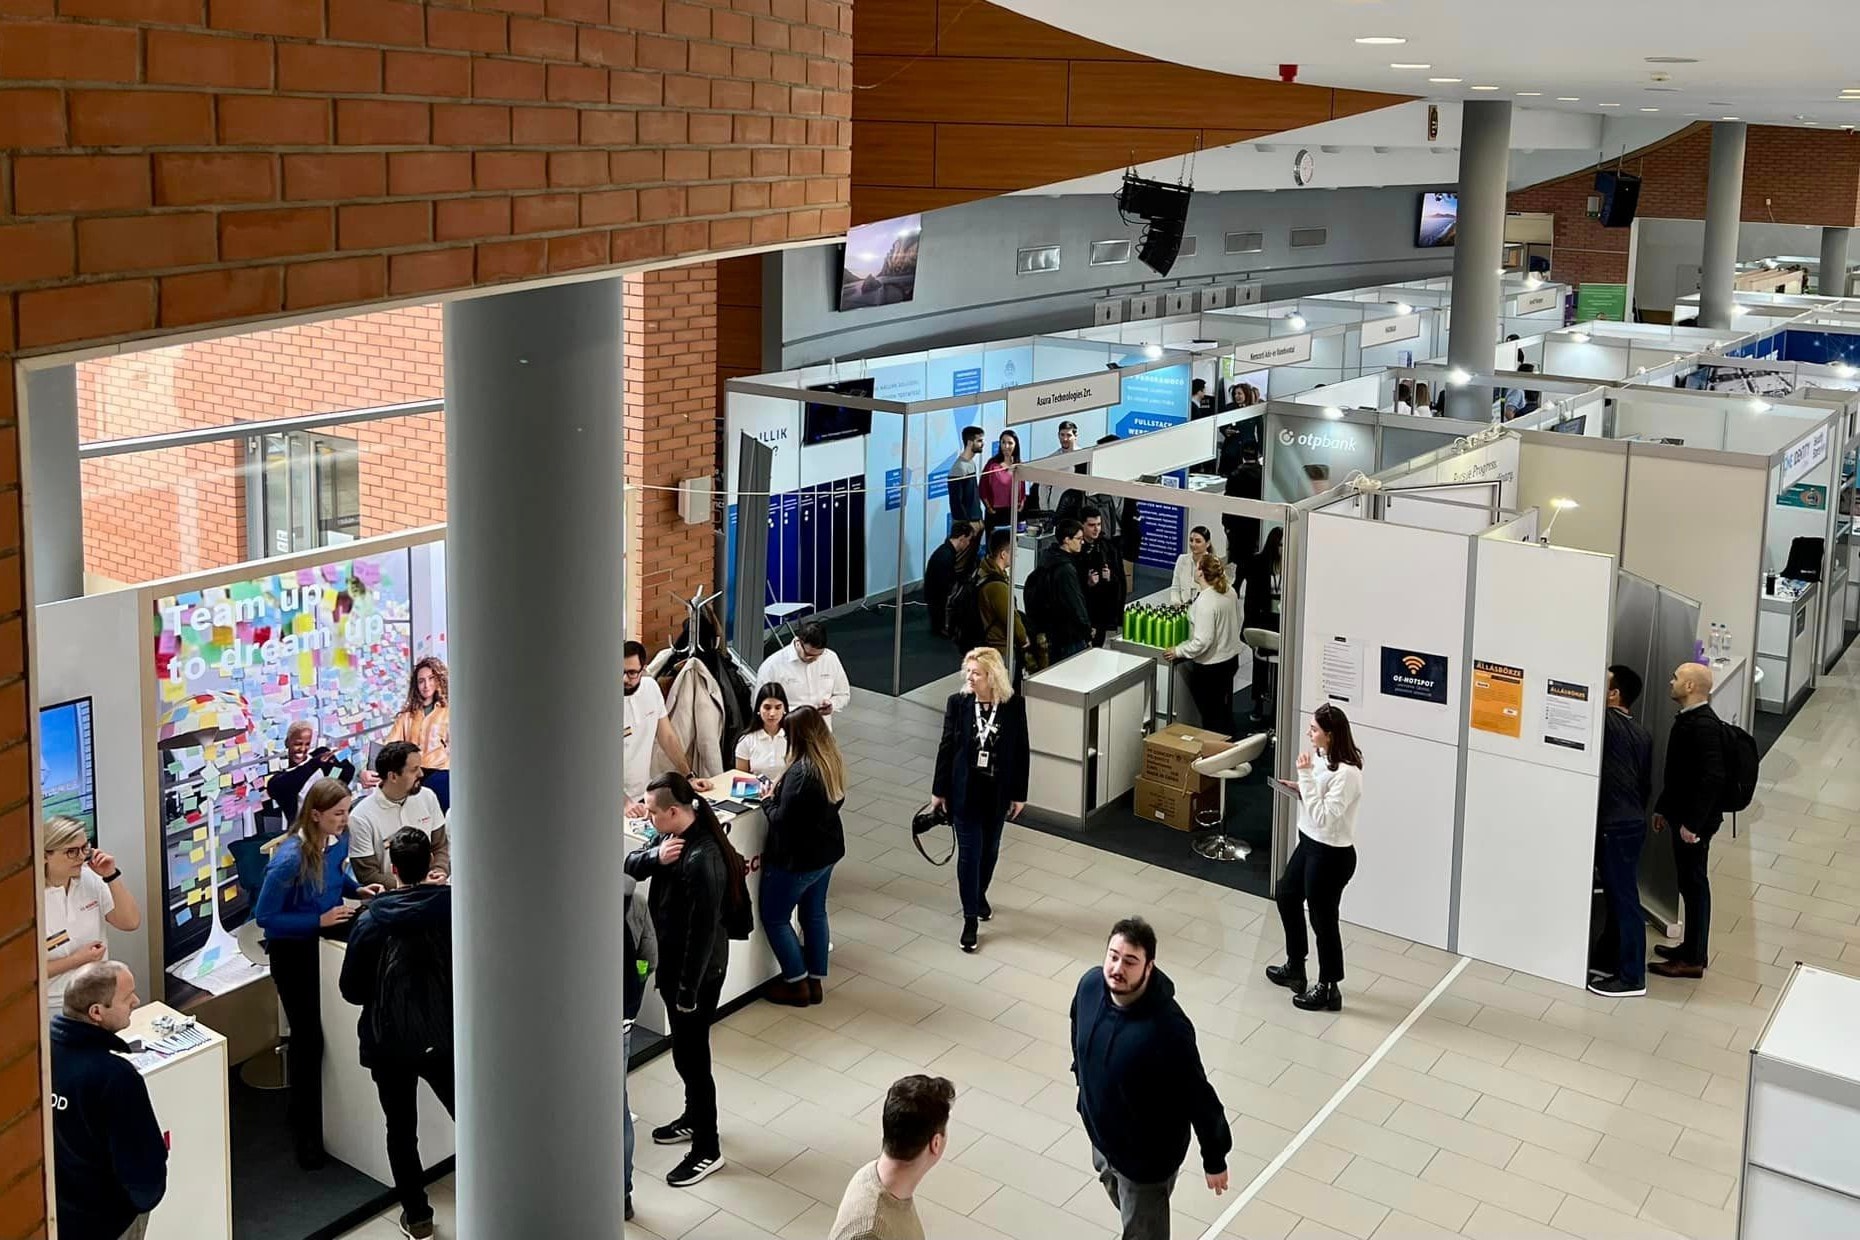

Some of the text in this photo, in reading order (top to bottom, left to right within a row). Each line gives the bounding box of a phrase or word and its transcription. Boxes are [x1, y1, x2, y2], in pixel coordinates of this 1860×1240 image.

[1037, 395, 1052, 406] Asura
[1052, 390, 1083, 404] Technologies
[1298, 433, 1357, 451] otpbank
[165, 583, 323, 637] Team up
[166, 613, 385, 684] to dream up
[1393, 675, 1435, 688] OE-HOTSPOT
